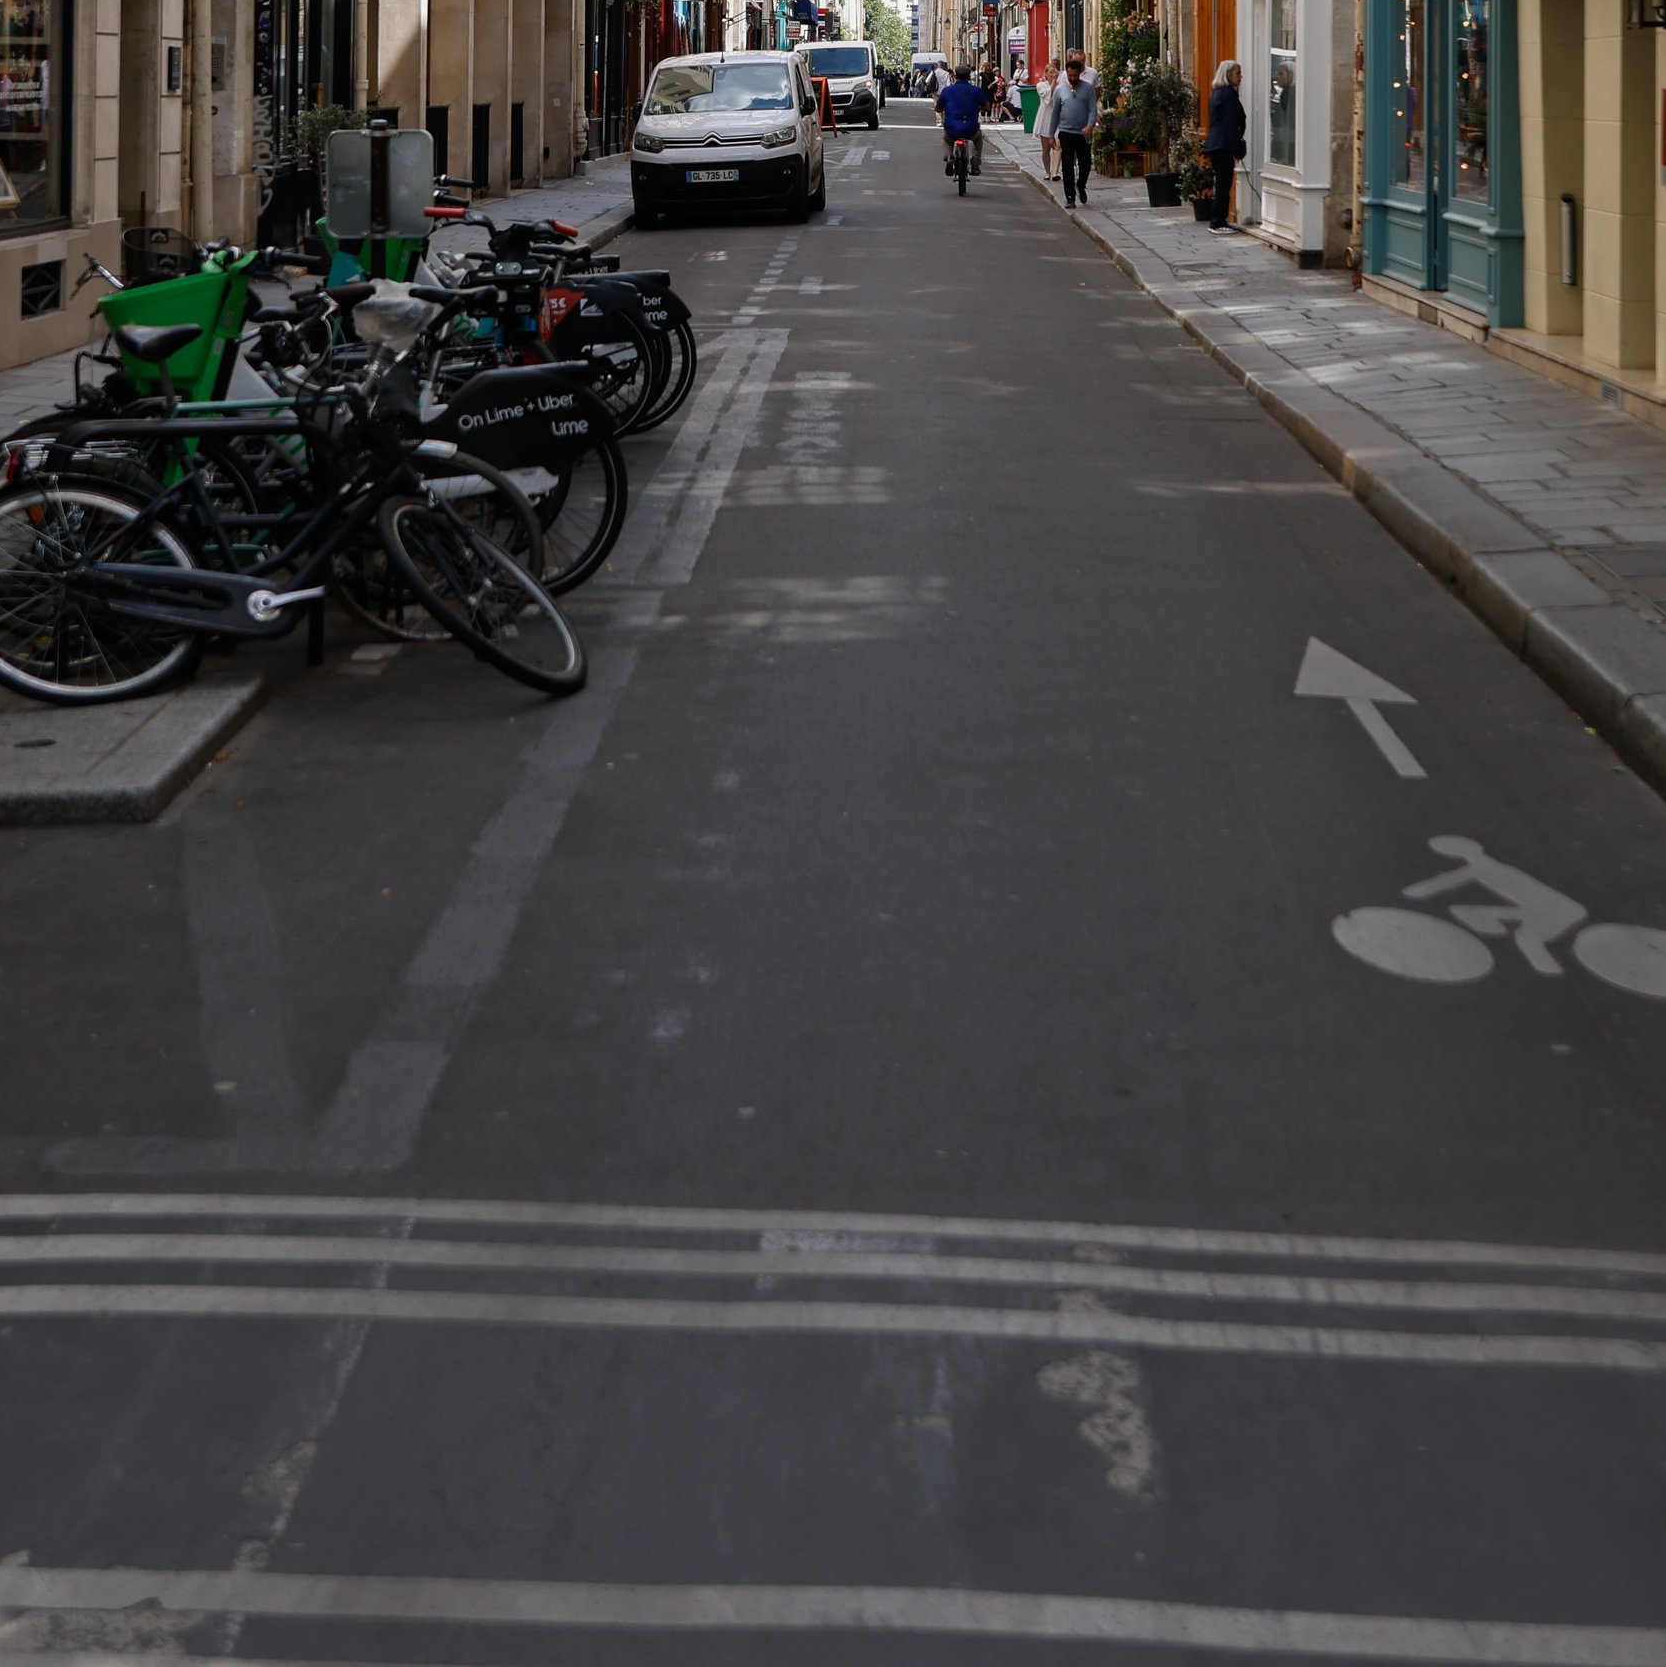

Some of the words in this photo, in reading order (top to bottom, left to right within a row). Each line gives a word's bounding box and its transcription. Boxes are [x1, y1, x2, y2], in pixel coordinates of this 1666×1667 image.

[642, 295, 662, 306] ber
[458, 413, 483, 430] On
[485, 403, 524, 425] Lime
[537, 393, 574, 412] Uber
[551, 419, 589, 436] Lime
